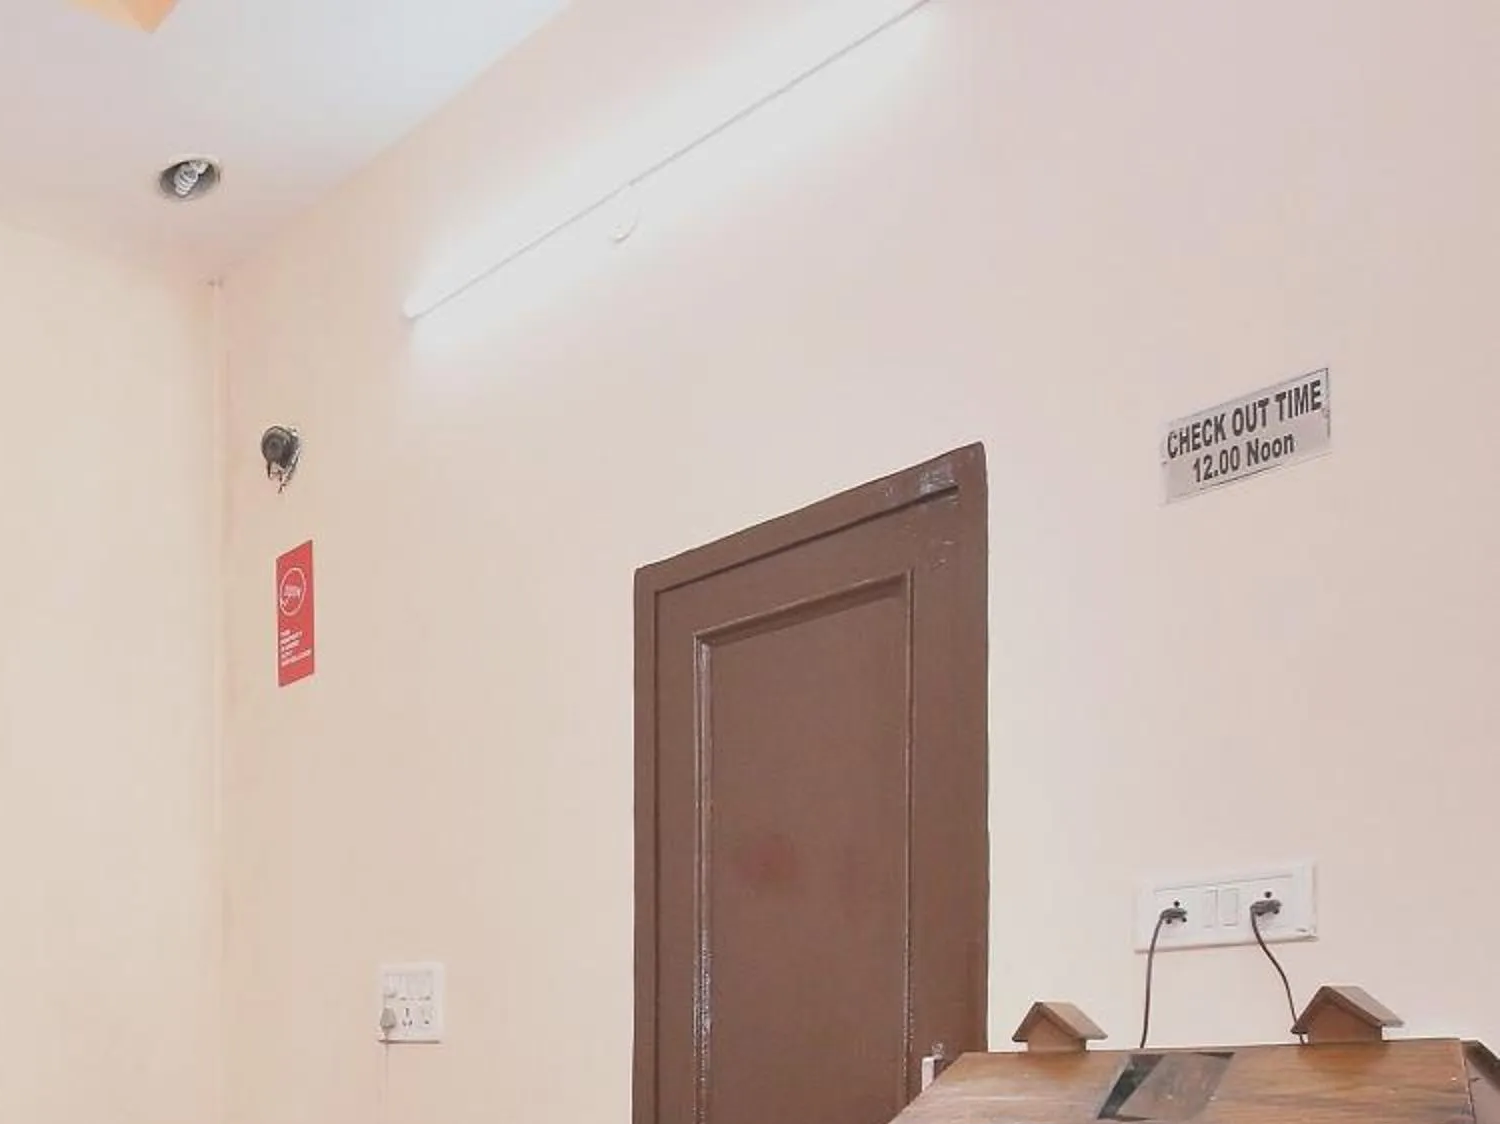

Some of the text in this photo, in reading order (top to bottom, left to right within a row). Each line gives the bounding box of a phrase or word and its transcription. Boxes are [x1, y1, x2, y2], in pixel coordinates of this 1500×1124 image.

[1167, 379, 1322, 459] CHECK OUT TIME
[1192, 433, 1295, 483] 12.00 Noon
